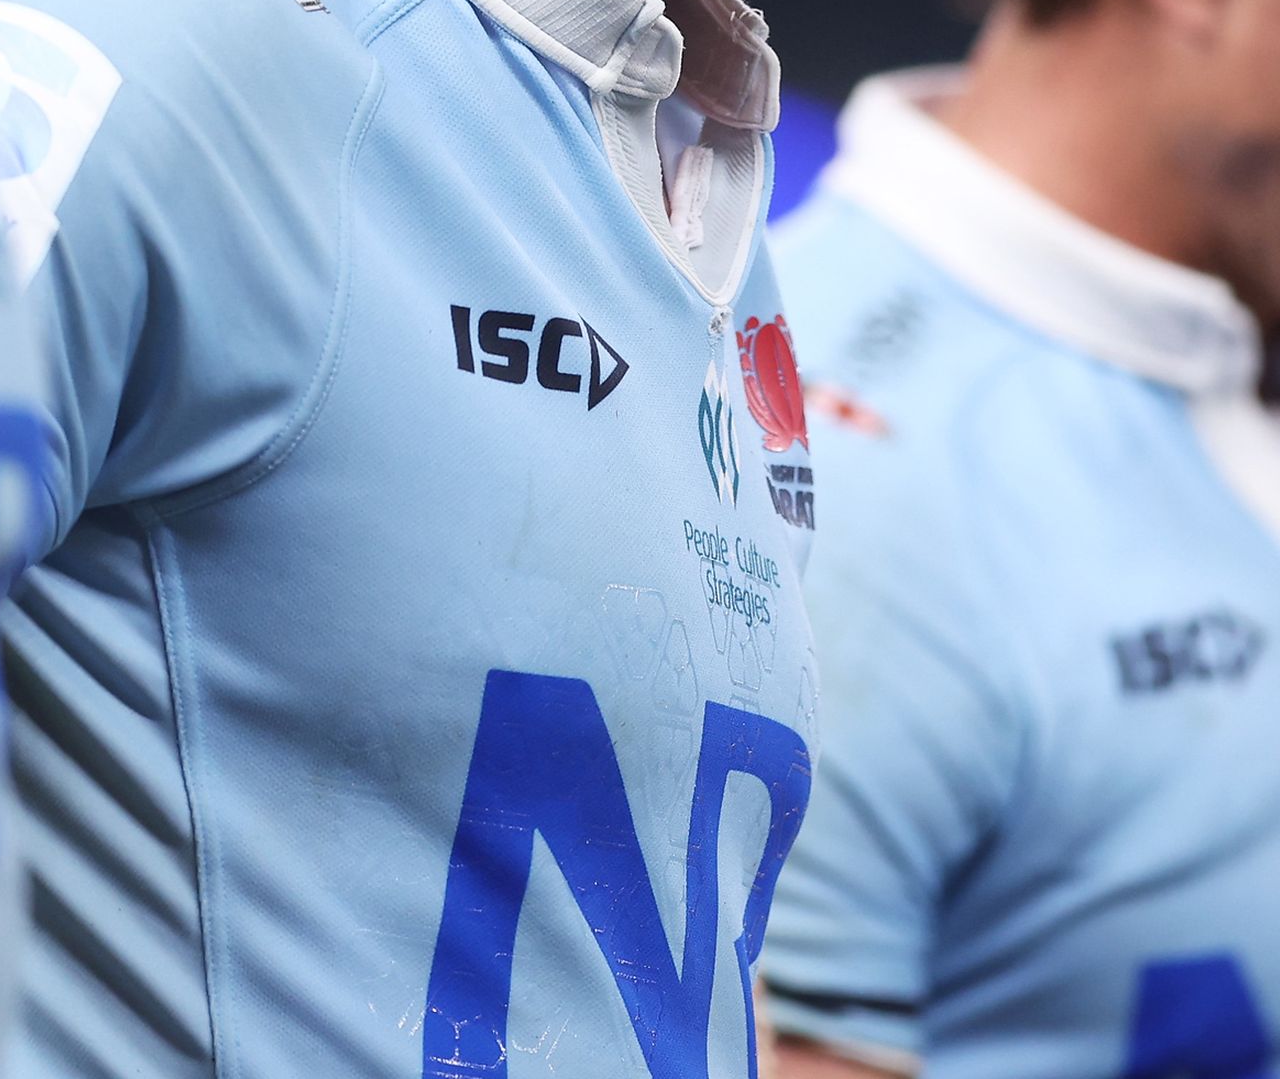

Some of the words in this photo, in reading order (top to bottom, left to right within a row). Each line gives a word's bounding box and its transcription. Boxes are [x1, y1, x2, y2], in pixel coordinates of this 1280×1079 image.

[449, 303, 584, 394] ISC
[683, 519, 730, 567] People
[735, 536, 781, 589] Culture
[706, 560, 771, 628] Strategies
